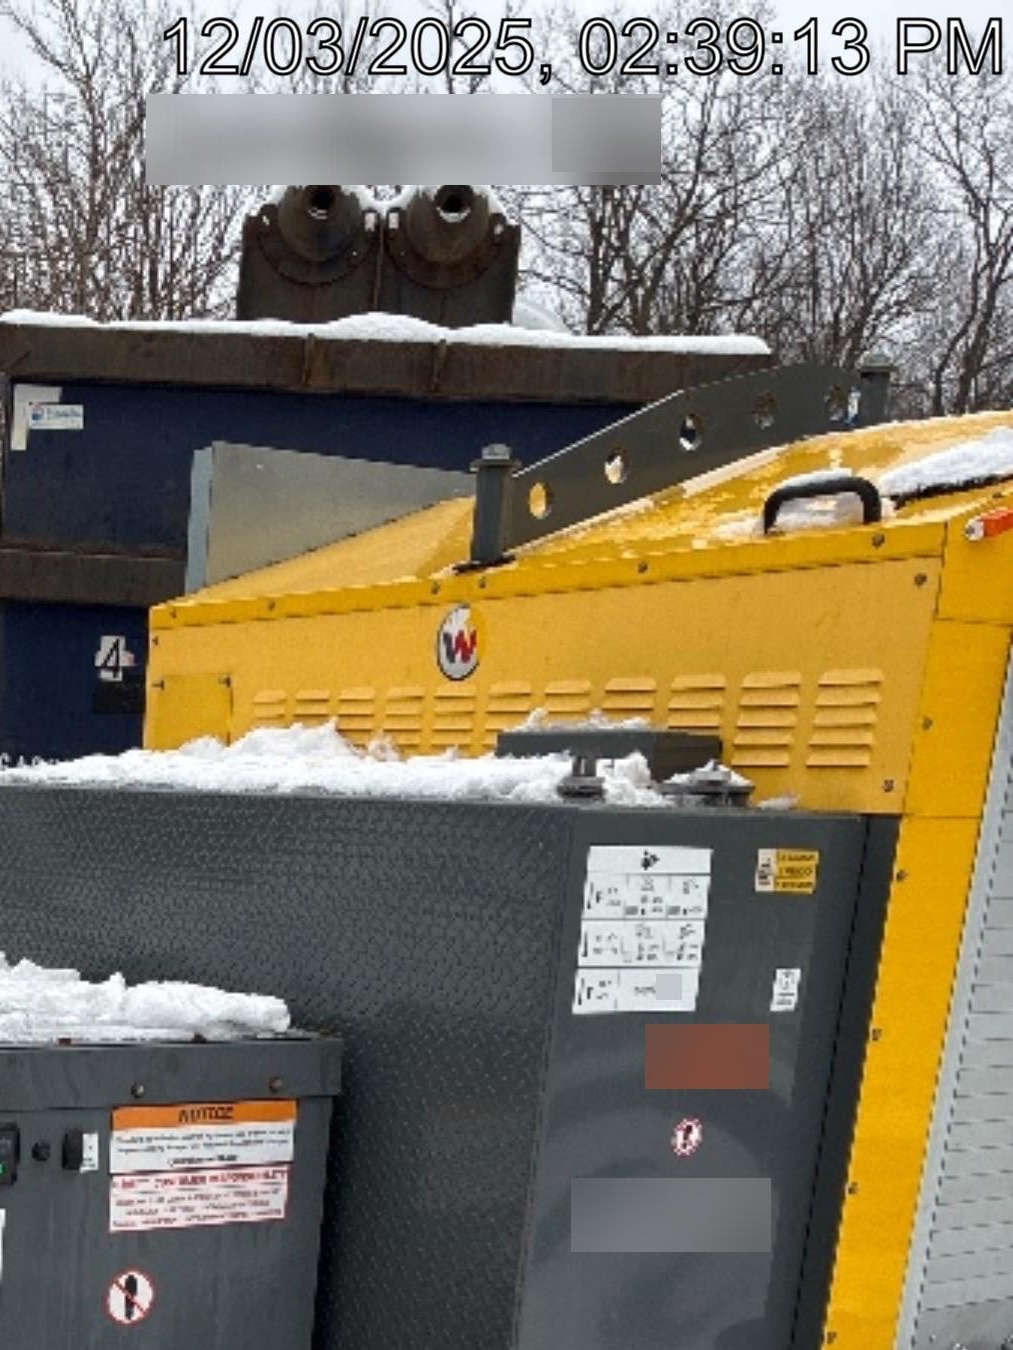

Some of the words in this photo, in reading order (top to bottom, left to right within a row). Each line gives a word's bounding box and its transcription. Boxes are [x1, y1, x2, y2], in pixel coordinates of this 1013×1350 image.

[95, 638, 125, 679] 4
[443, 629, 477, 664] W
[178, 1106, 234, 1123] NOTICE
